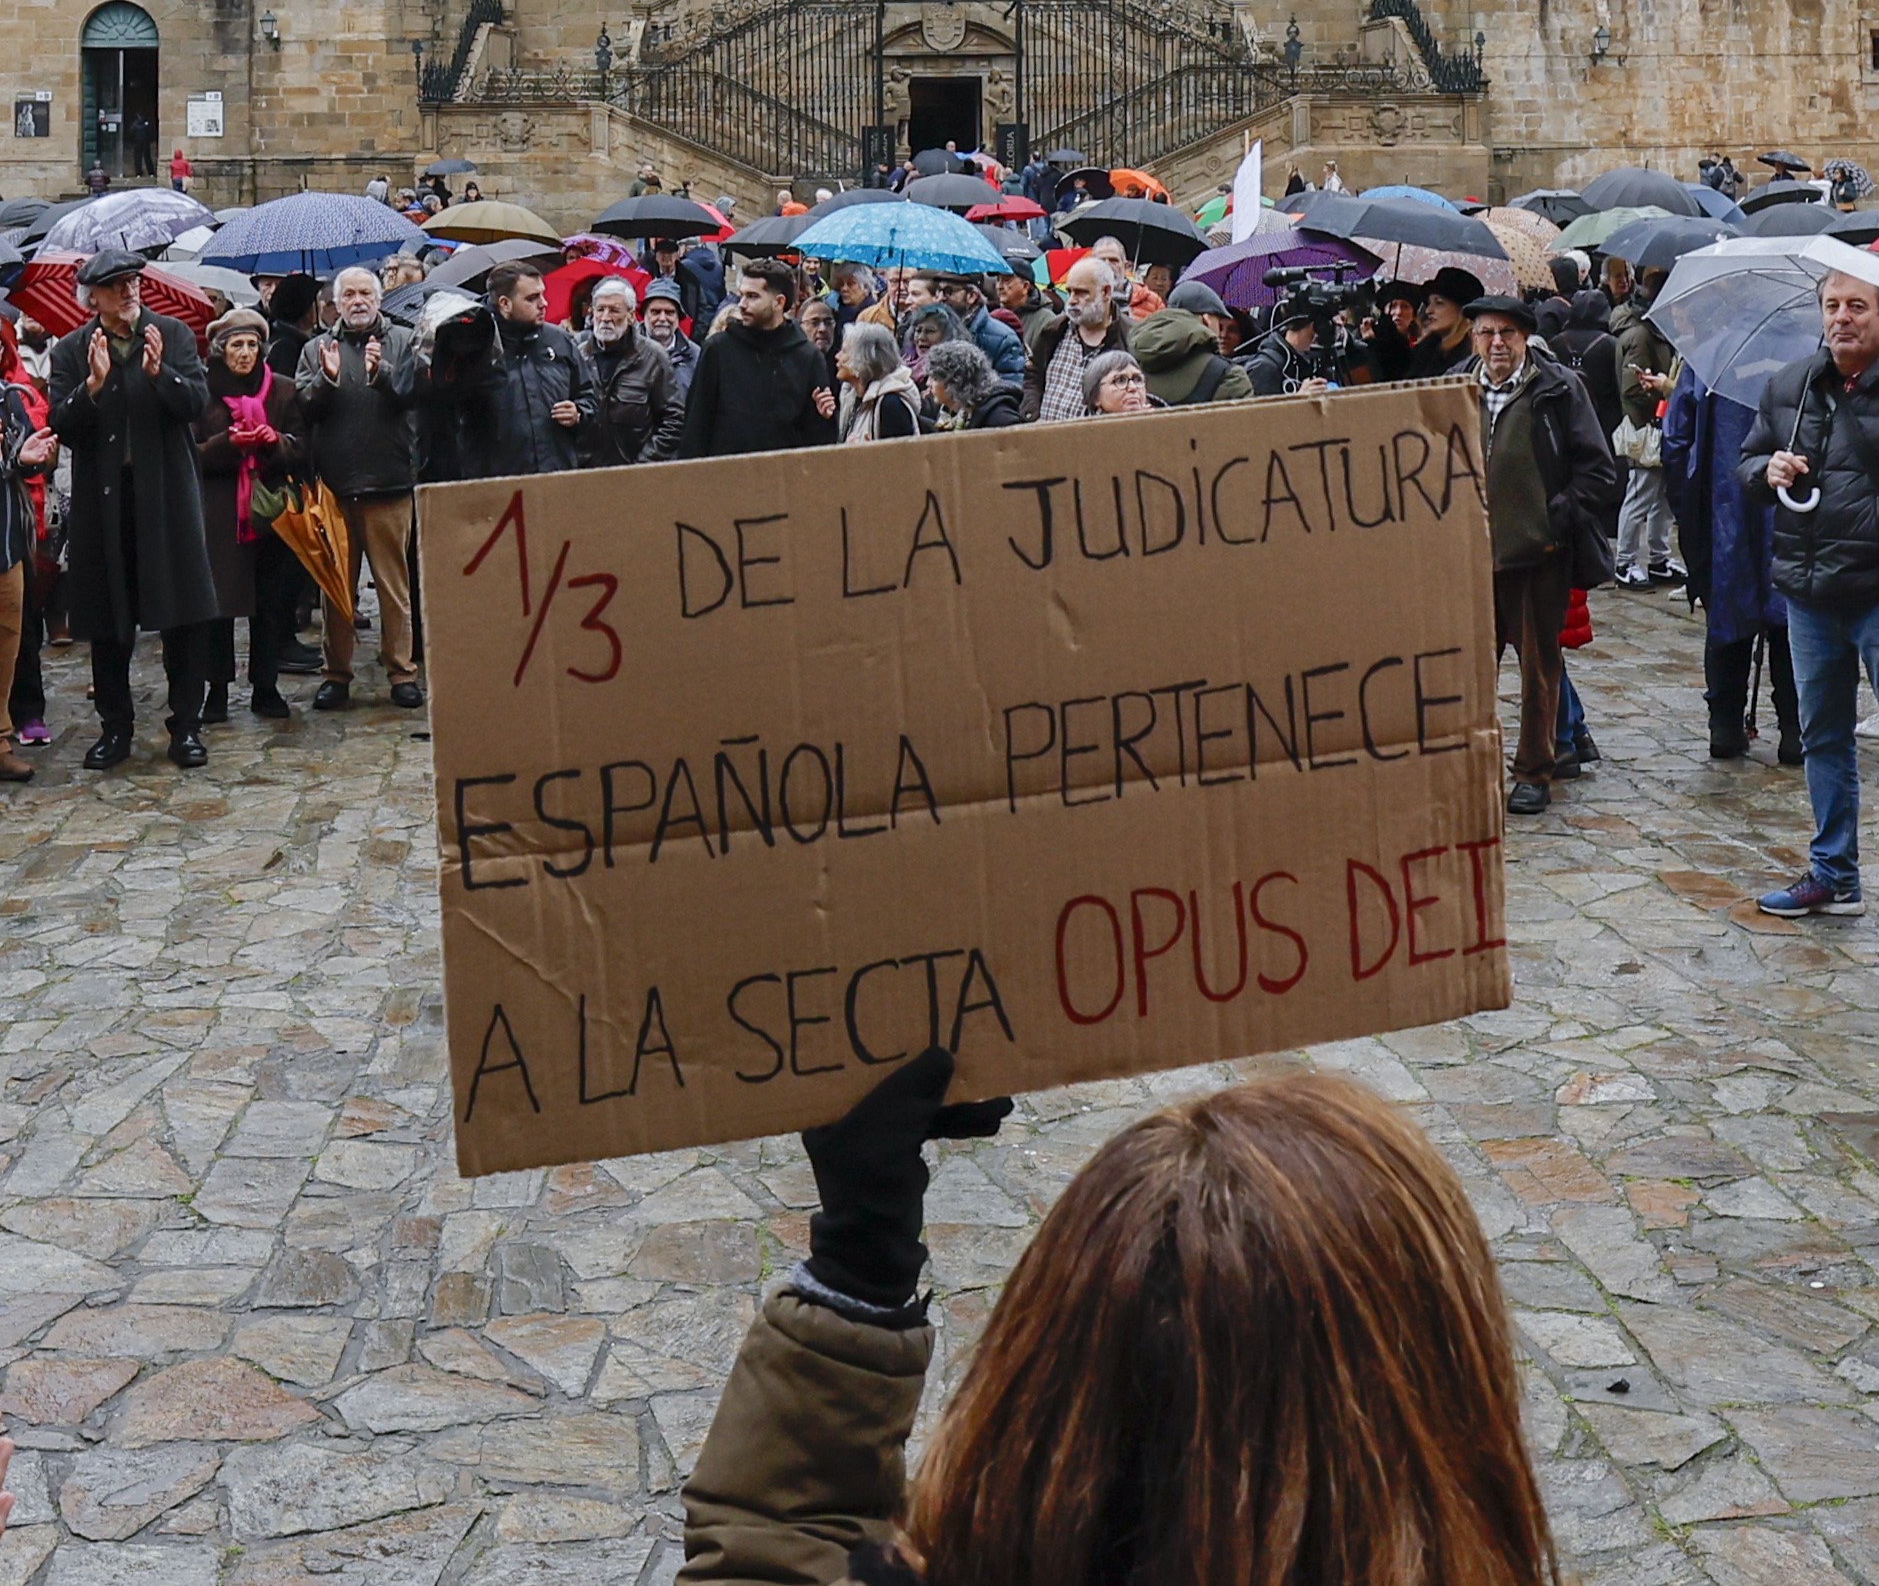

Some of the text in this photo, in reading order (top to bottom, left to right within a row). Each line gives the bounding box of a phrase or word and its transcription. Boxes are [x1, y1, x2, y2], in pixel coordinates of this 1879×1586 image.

[463, 489, 624, 688] 1/3
[676, 511, 796, 620] DE
[839, 490, 963, 599] LA
[453, 647, 1470, 891] ESPAÑOLA PERTENECE
[464, 836, 1508, 1123] A LA SECTA OPUS DEI
